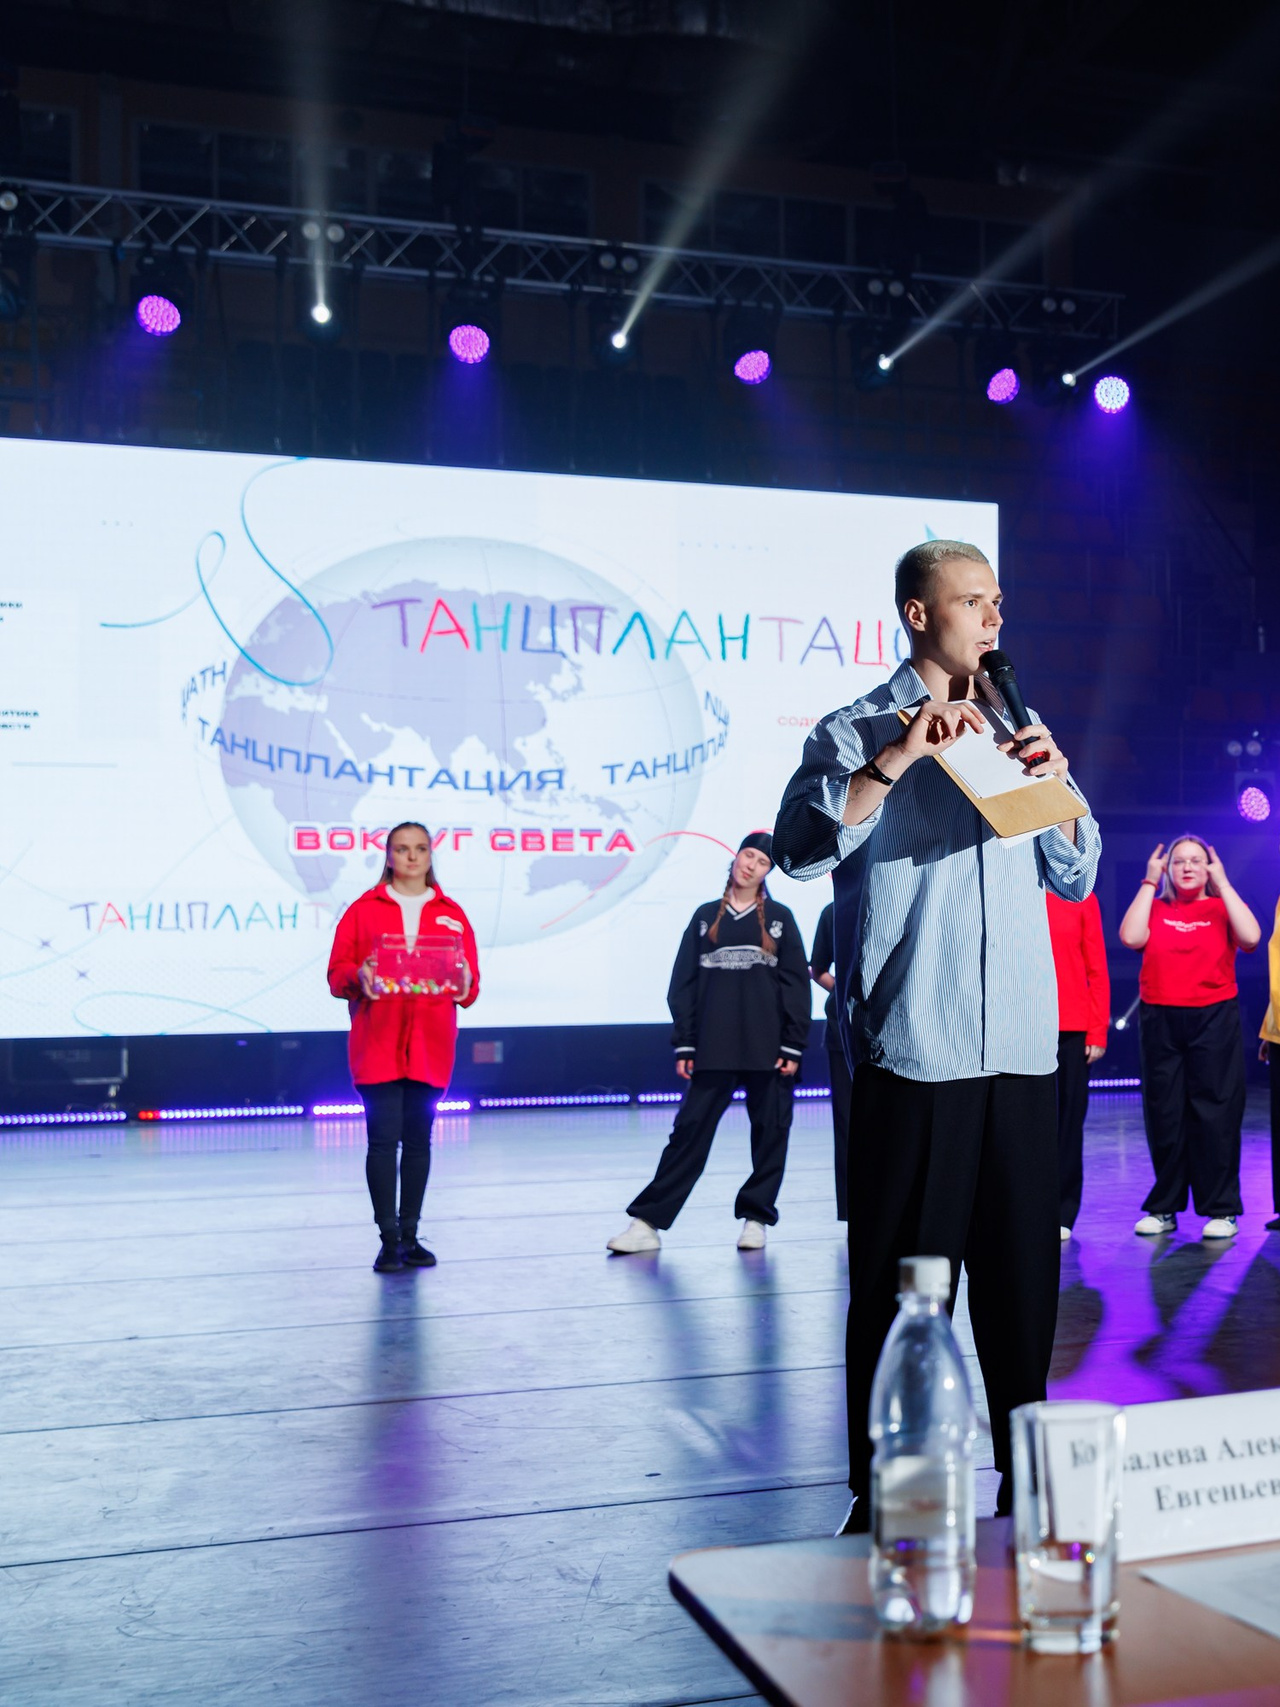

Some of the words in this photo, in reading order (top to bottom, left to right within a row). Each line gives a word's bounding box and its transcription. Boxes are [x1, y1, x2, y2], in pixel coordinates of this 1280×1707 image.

[198, 717, 565, 796] ТАНЦПЛАНТАЦИЯ
[294, 826, 473, 852] ВОКУГ
[490, 827, 636, 853] СВЕТА
[1069, 1438, 1208, 1473] Коалева
